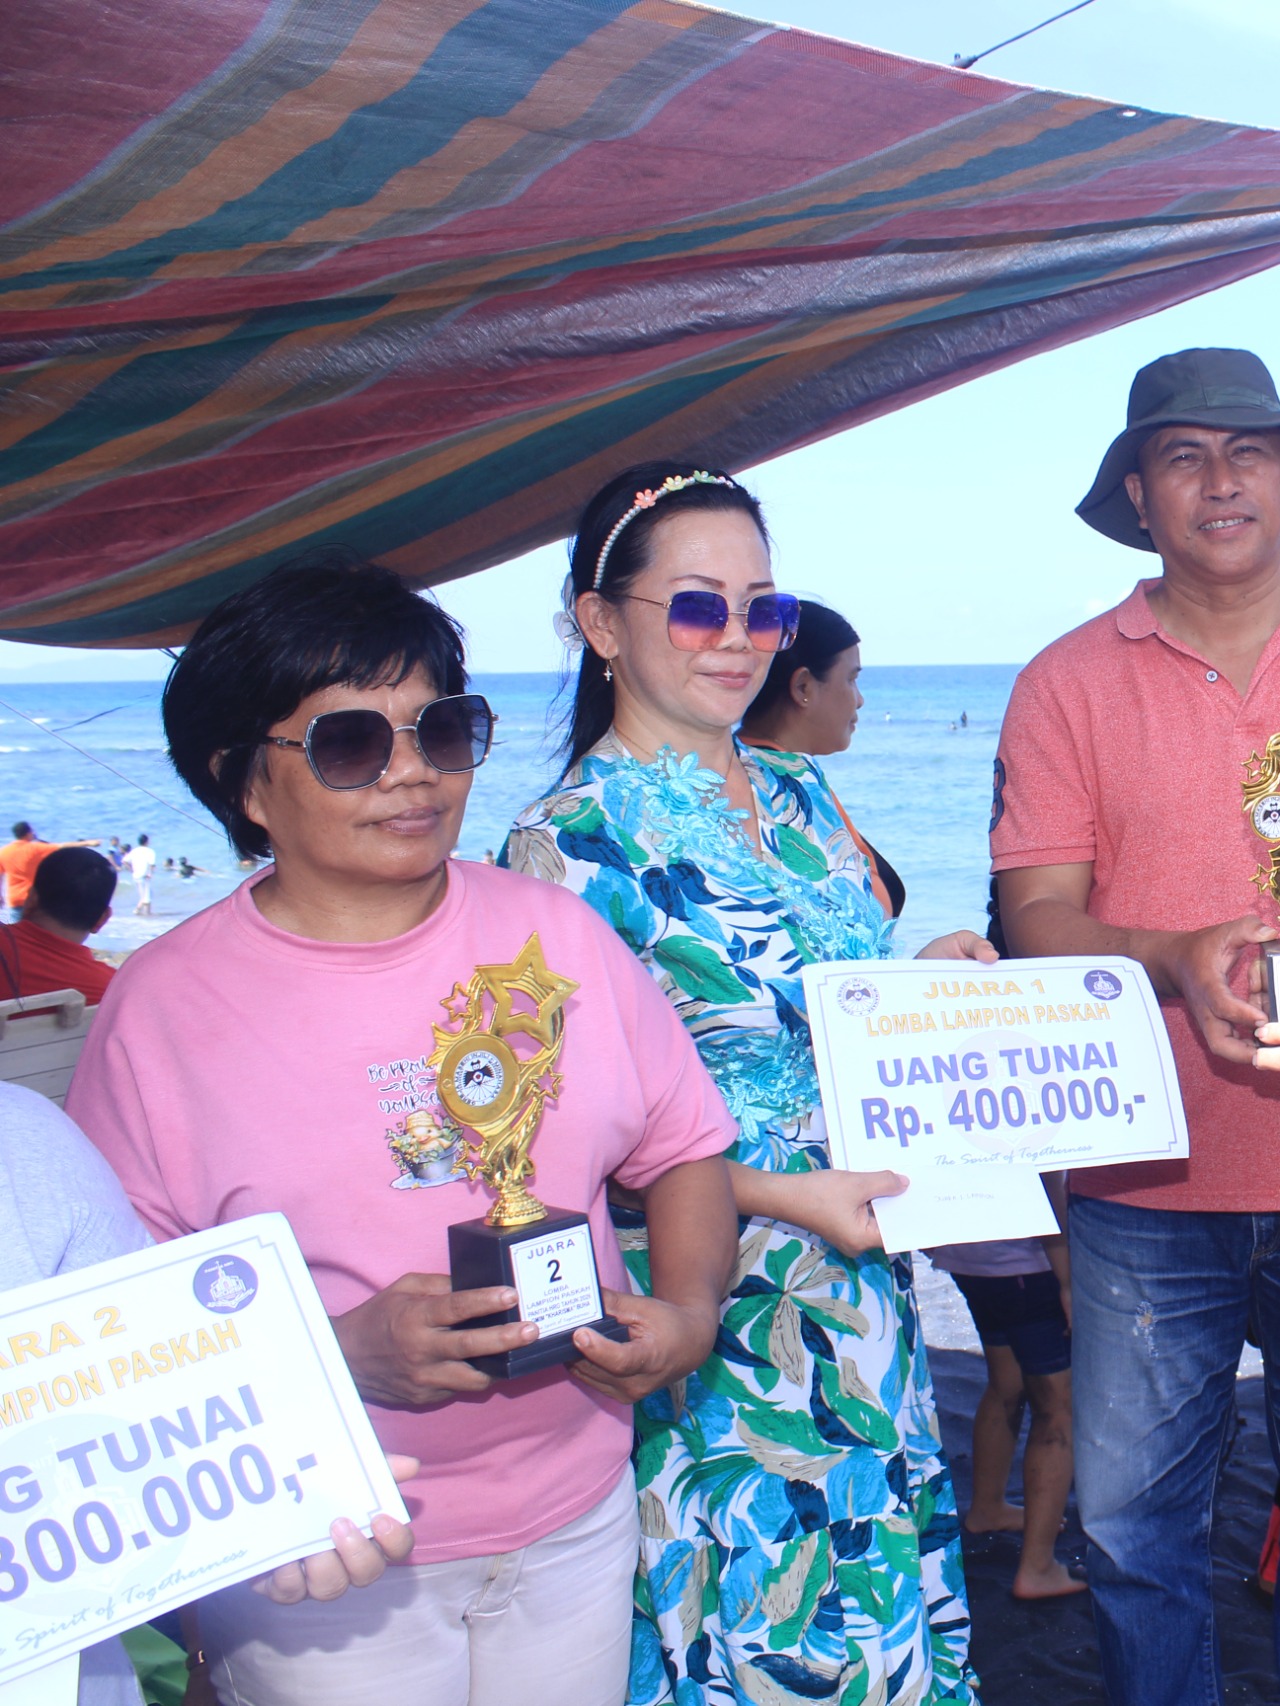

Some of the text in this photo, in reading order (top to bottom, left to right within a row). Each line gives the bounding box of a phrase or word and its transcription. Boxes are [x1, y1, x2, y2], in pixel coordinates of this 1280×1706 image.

[922, 978, 1046, 999] JUARA 1
[865, 1002, 1111, 1037] LOMBA LAMPION PASKAH
[389, 1056, 434, 1076] PROU
[876, 1041, 1119, 1088] UANG TUNAI
[860, 1076, 1146, 1148] Rp. 400.000,-
[934, 1144, 1094, 1167] The Spirit of Togetherness
[527, 1239, 575, 1259] JUARA
[547, 1259, 562, 1283] 2
[527, 1286, 591, 1309] LAMPION PASKAH
[543, 1284, 569, 1296] LOMBA
[93, 1306, 127, 1340] 2
[108, 1318, 243, 1389] PASKAH
[56, 1384, 265, 1489] TUNAI
[15, 1546, 249, 1650] Spirit of Togetherness
